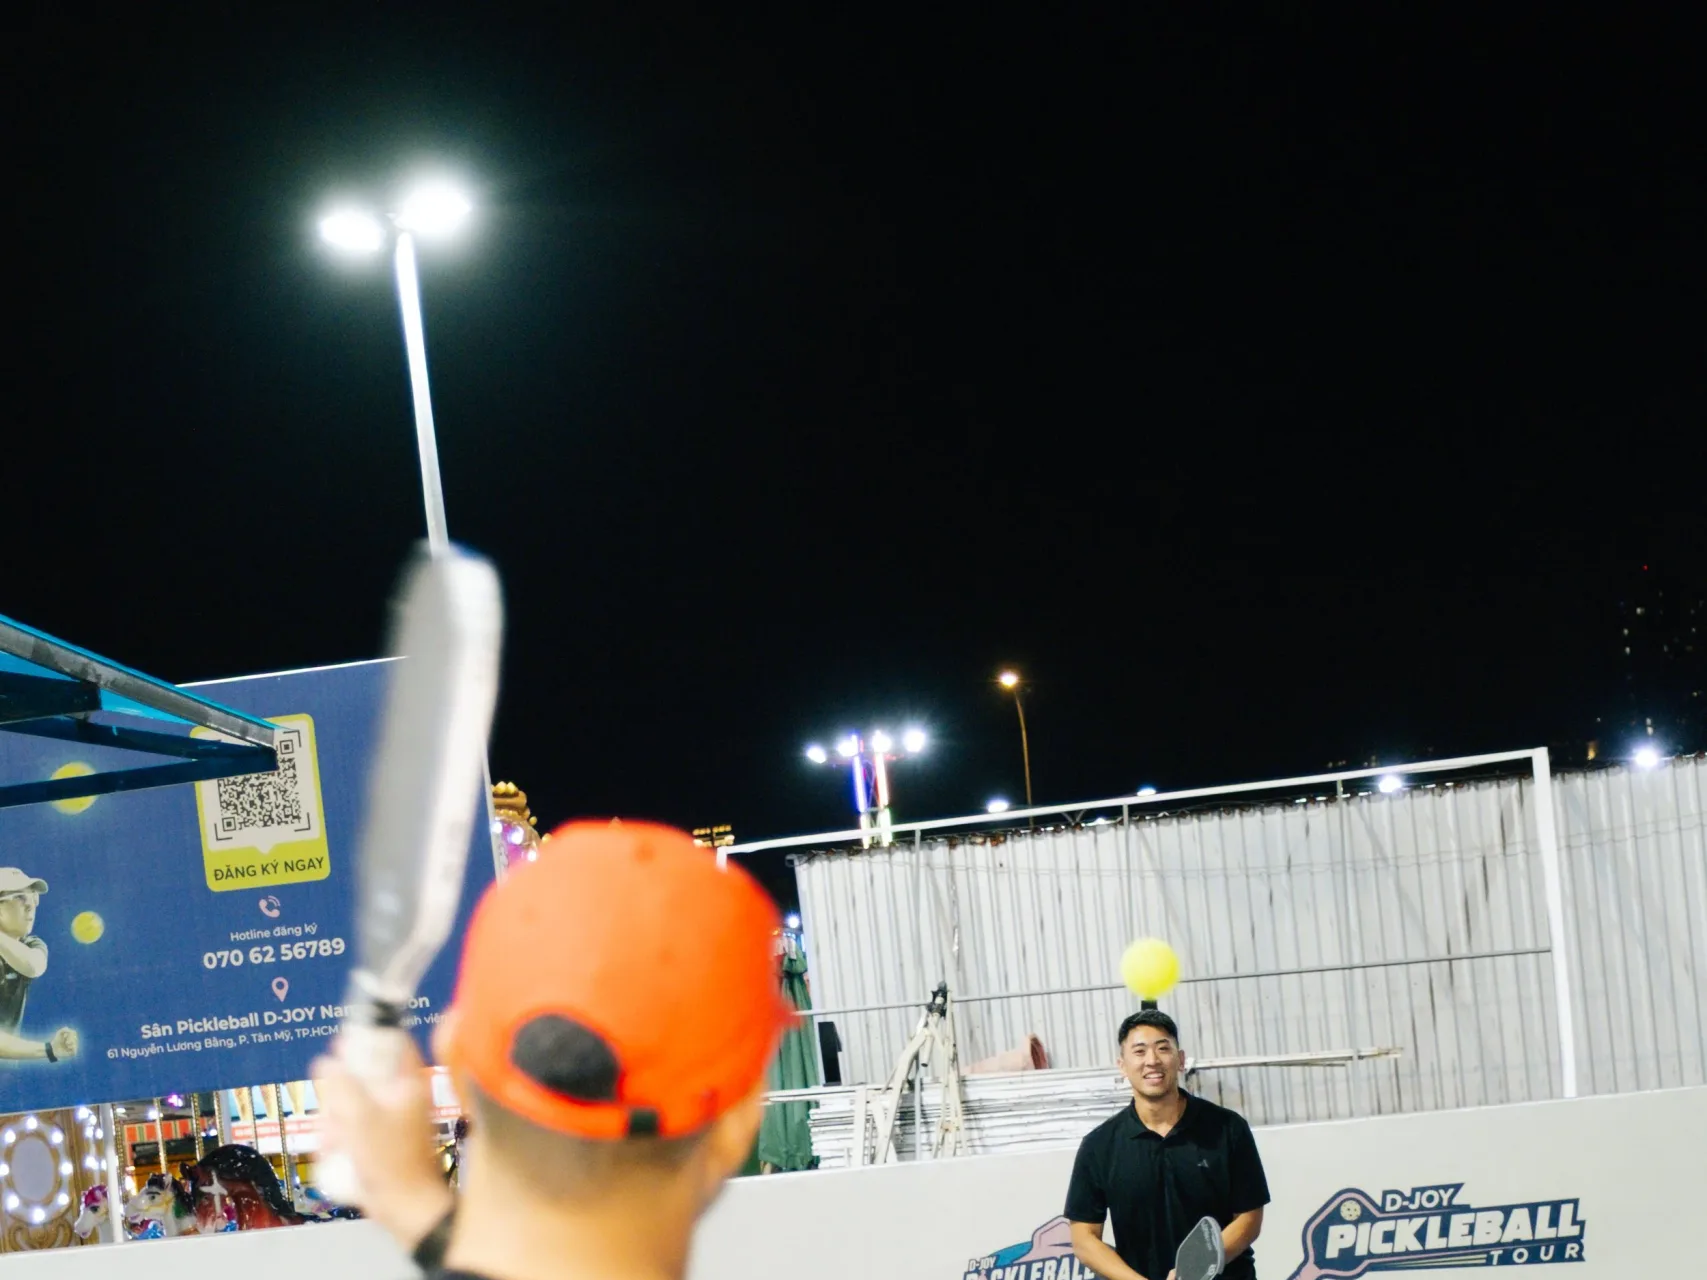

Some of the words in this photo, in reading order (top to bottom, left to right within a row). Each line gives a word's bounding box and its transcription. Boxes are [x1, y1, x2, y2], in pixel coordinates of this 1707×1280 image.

[213, 865, 257, 881] ĐĂNG
[261, 859, 279, 875] KÝ
[284, 857, 324, 872] NGAY
[230, 929, 271, 942] Hotline
[273, 926, 302, 938] đăng
[304, 922, 318, 935] ký
[203, 950, 244, 969] 070
[249, 945, 276, 964] 62
[280, 938, 346, 961] 56789
[141, 1023, 173, 1039] Sân
[177, 1012, 260, 1035] Pickleball
[263, 1007, 316, 1026] D-JOY
[107, 1049, 119, 1059] 61
[239, 1034, 250, 1045] P.
[251, 1031, 272, 1043] Tân
[295, 1024, 339, 1039] TP.HCM
[1385, 1187, 1455, 1212] D-JOY
[1325, 1202, 1581, 1260] PICKLEBALL
[968, 1256, 997, 1272] D-JOY
[1489, 1242, 1583, 1267] TOUR
